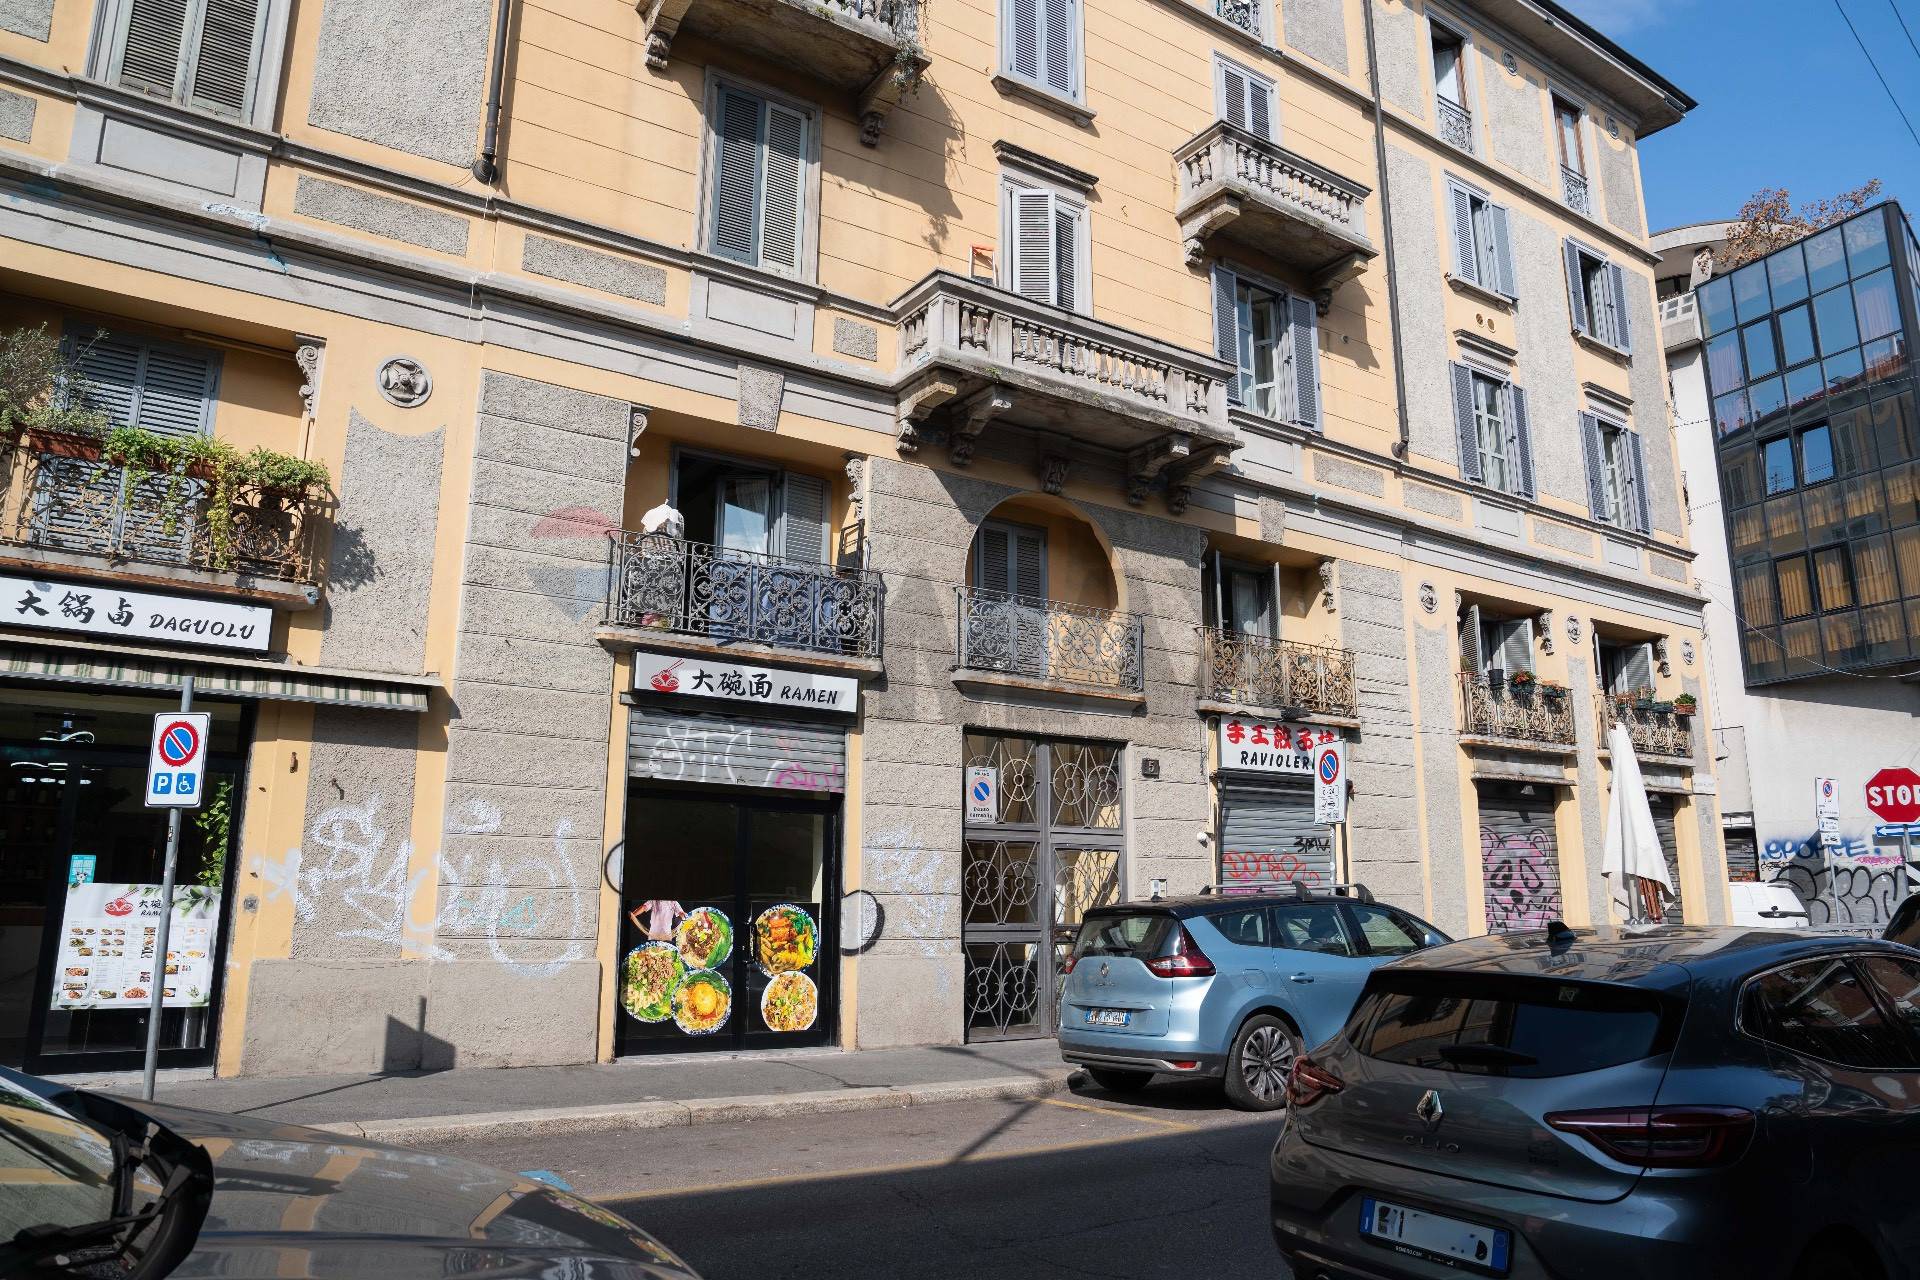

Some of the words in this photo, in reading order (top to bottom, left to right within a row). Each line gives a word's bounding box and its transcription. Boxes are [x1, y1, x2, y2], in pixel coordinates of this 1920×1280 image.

[15, 589, 135, 627] 大锅卤
[148, 613, 256, 640] DAGUOLU
[691, 668, 773, 699] 大碗面
[780, 685, 839, 705] RAMEN
[157, 775, 169, 792] P
[1403, 1135, 1462, 1154] CLIO
